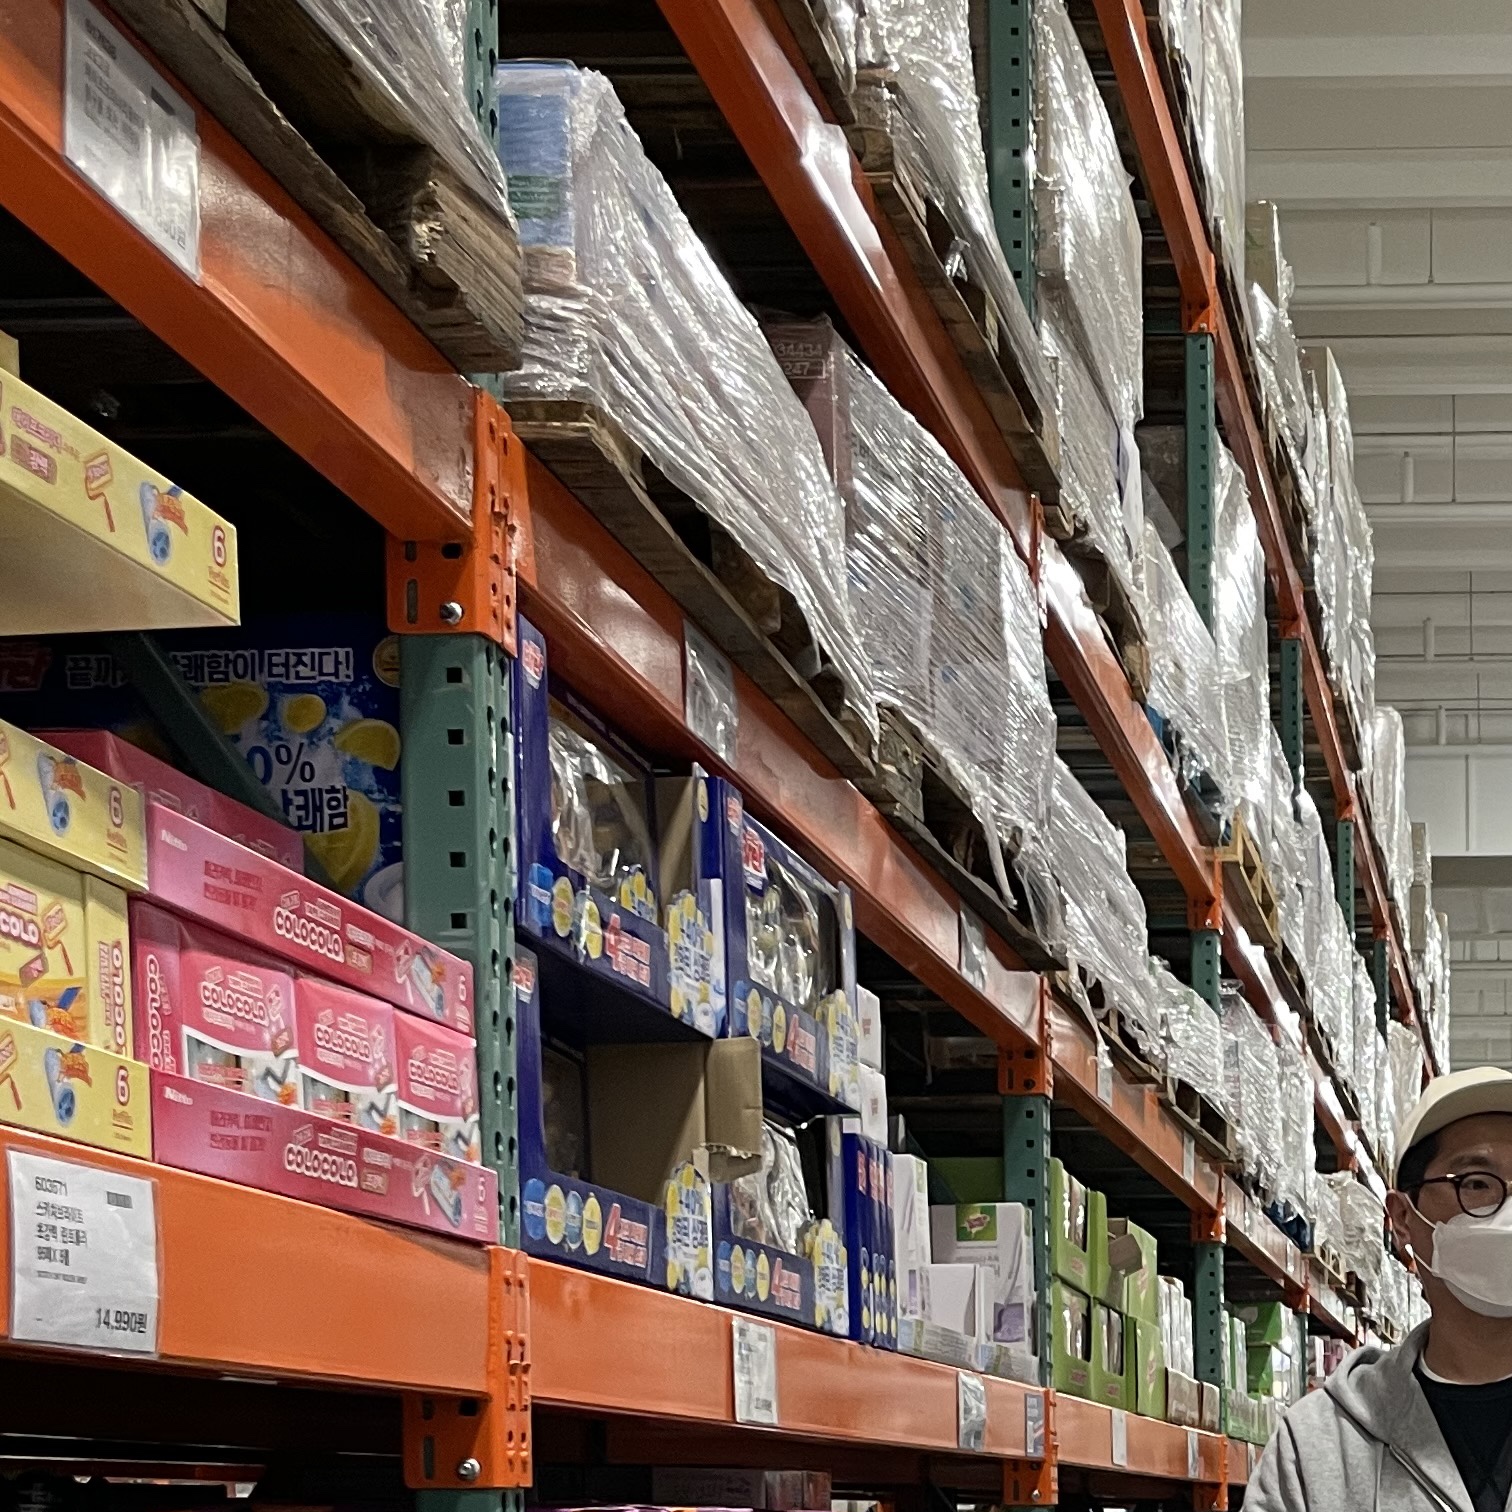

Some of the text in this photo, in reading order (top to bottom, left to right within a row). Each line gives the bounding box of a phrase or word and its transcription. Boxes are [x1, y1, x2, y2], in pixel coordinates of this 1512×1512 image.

[213, 525, 227, 568] 6
[265, 648, 353, 683] 터진다!
[108, 786, 125, 829] 6
[273, 906, 346, 963] COLOCOLO
[200, 981, 271, 1026] COLOCOLO
[314, 1023, 372, 1062] COLOCOLO
[116, 1065, 131, 1106] 6
[407, 1058, 460, 1095] COLOCOLO
[284, 1142, 358, 1188] COLOCOLO
